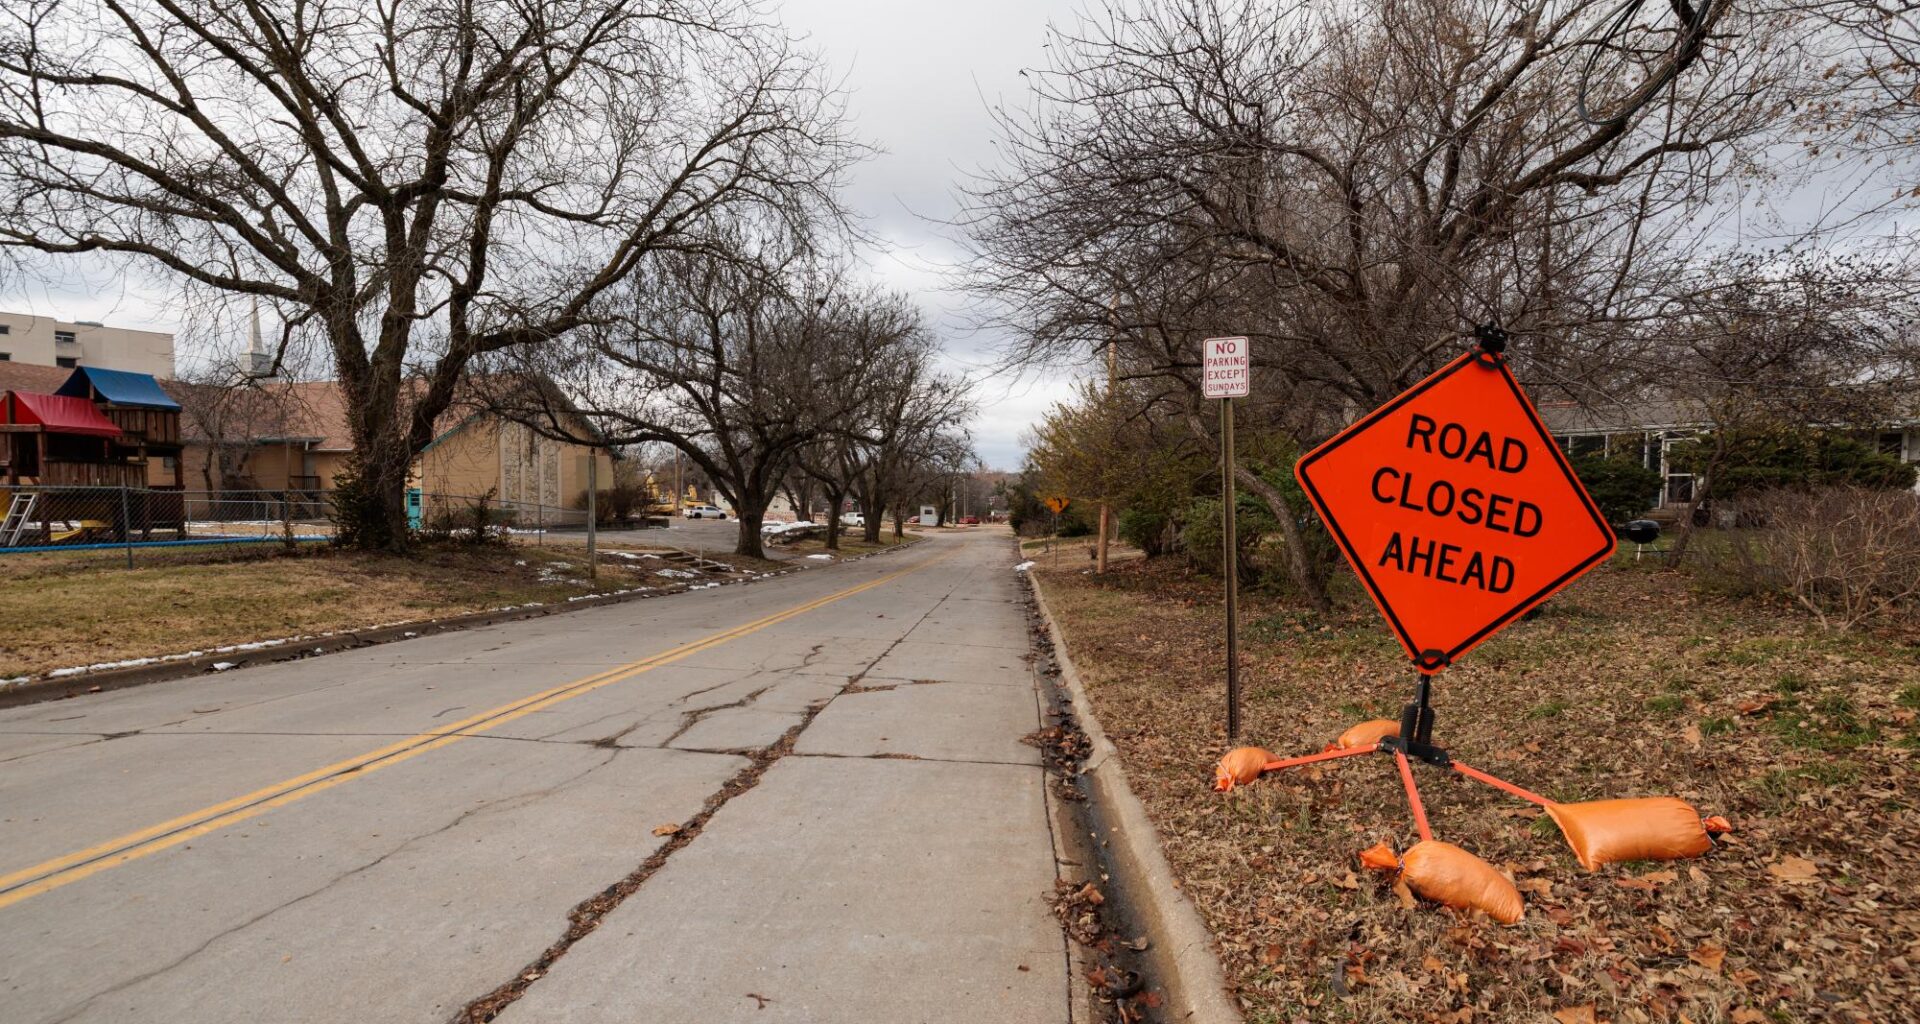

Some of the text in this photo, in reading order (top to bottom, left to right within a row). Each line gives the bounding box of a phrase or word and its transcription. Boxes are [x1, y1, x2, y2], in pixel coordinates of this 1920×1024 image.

[1216, 342, 1236, 354] NO
[1207, 356, 1246, 367] PARKING
[1208, 369, 1246, 380] EXCEPT
[1207, 383, 1246, 392] SUNDAYS
[1406, 413, 1528, 473] ROAD
[1371, 466, 1543, 538] CLOSED
[1378, 532, 1515, 594] AHEAD
